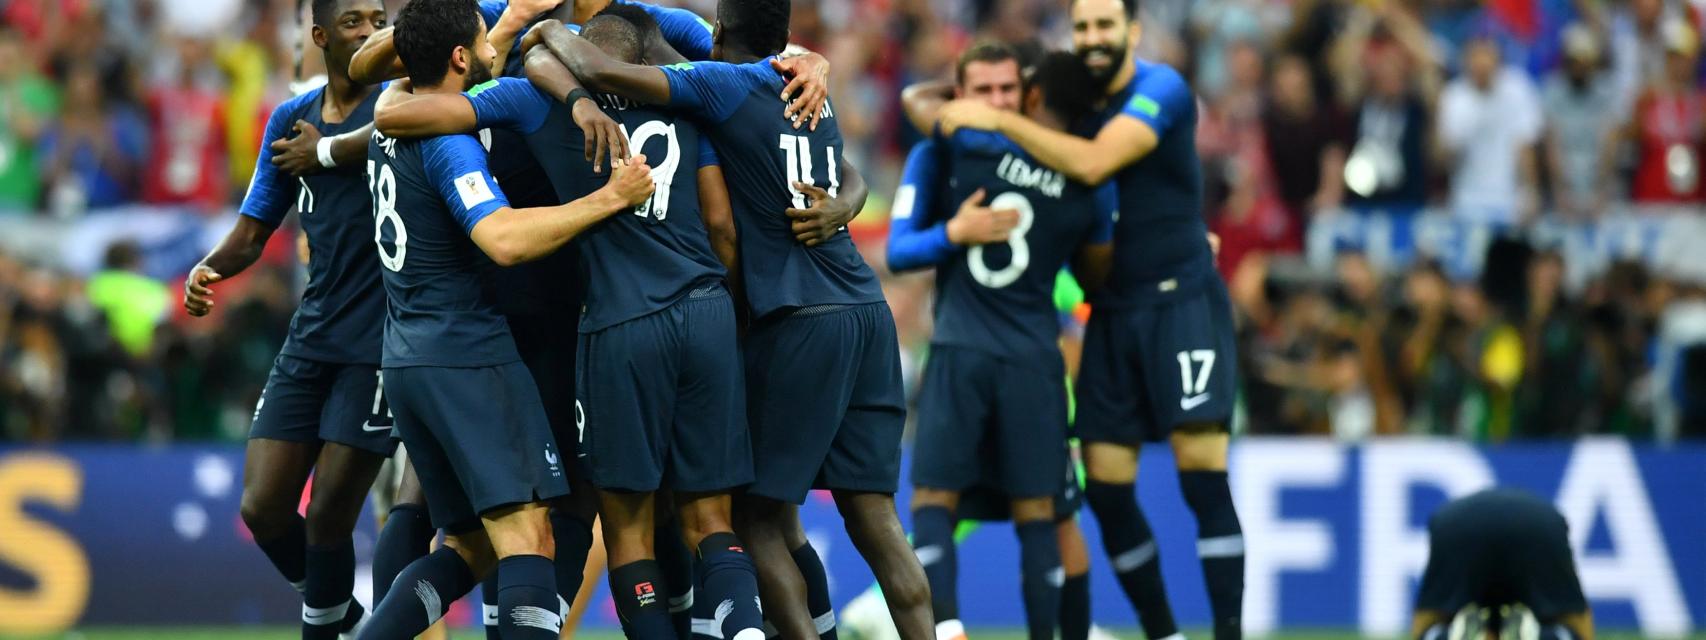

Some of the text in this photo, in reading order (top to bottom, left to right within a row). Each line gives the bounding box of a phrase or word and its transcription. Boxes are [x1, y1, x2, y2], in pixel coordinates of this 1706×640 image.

[996, 152, 1066, 198] LEMAR
[966, 191, 1034, 289] 8
[1176, 348, 1216, 395] 17
[1228, 435, 1696, 637] FRA
